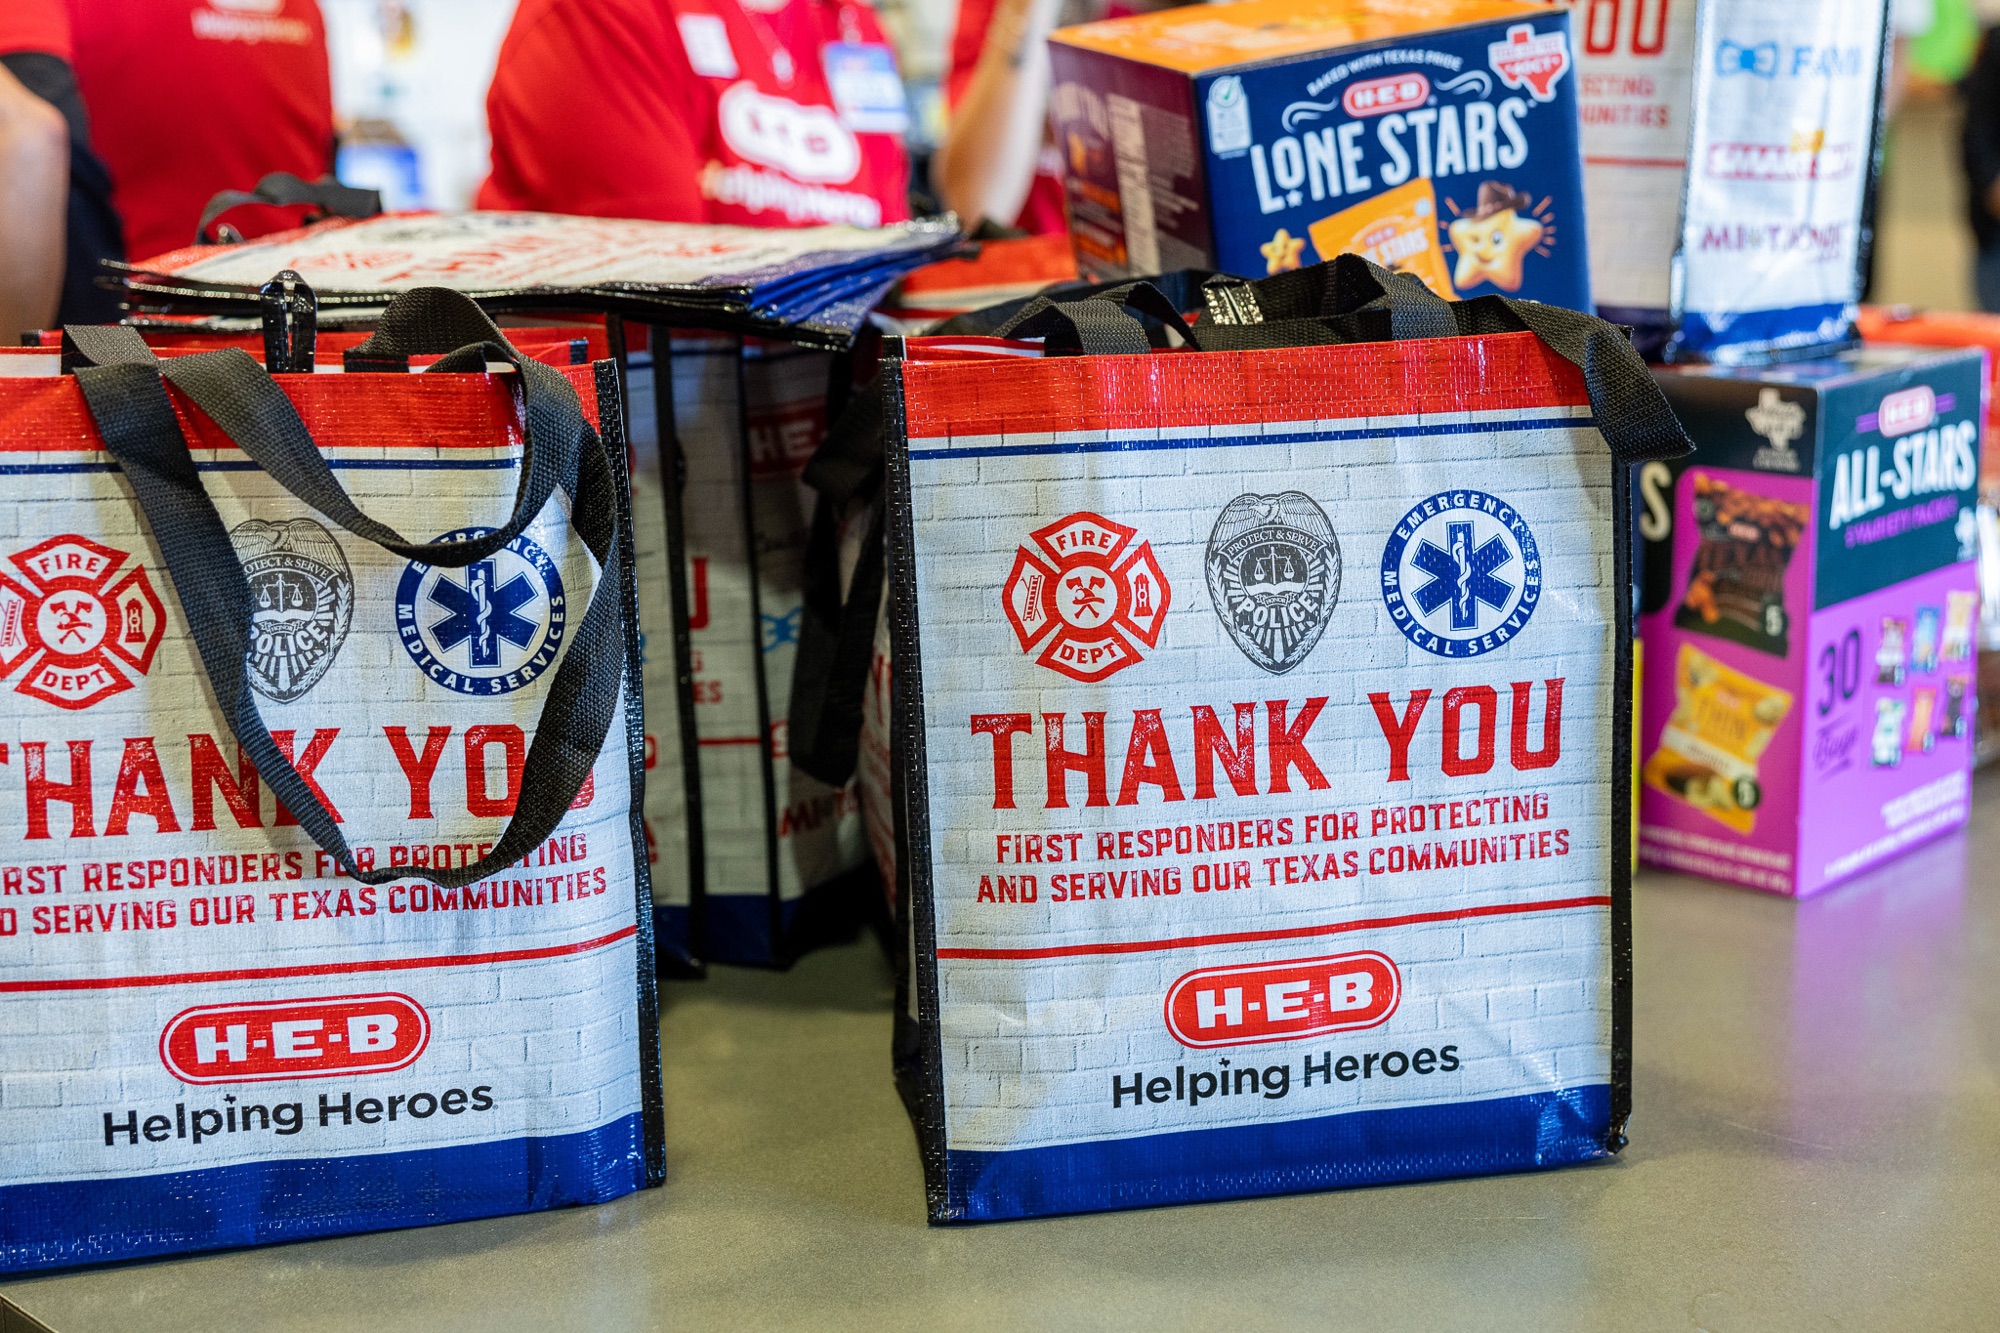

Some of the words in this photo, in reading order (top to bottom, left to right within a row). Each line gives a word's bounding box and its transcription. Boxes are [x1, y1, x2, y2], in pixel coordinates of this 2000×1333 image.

[1382, 49, 1426, 66] TEXAS
[1566, 0, 1668, 57] OU
[1250, 120, 1373, 215] LONE
[1376, 97, 1529, 186] STARS
[1829, 419, 1977, 531] ALL-STARS
[1055, 529, 1113, 552] FIRE
[1227, 530, 1275, 556] PROTECT
[1275, 530, 1285, 540] &
[1285, 530, 1320, 551] SERVE
[1396, 493, 1524, 541] EMERGENCY
[38, 553, 101, 575] FIRE
[243, 556, 283, 574] OTECT
[294, 558, 330, 579] SERVE
[1235, 591, 1320, 629] POLICE
[1383, 570, 1454, 655] MEDICAL
[1467, 559, 1540, 655] SERVICES
[397, 603, 475, 693] MEDICAL
[491, 594, 565, 693] SERVICES
[1058, 642, 1117, 665] DEPT
[1816, 627, 1861, 717] 30
[42, 669, 107, 692] DEPT
[970, 695, 1332, 809] THANK
[1367, 677, 1567, 782] YOU
[0, 728, 345, 840] HANK
[382, 723, 595, 820] YO
[996, 832, 1083, 863] FIRST
[1096, 817, 1294, 860] RESPONDERS
[1304, 811, 1360, 843] FOR
[1371, 792, 1549, 837] PROTECTING
[2, 864, 67, 896] RST
[82, 851, 303, 893] RESPONDERS
[976, 875, 1038, 903] AND
[1051, 866, 1182, 903] SERVING
[1192, 860, 1252, 893] OUR
[1263, 850, 1359, 887] TEXAS
[1369, 828, 1571, 876] COMMUNITIES
[33, 899, 177, 934] SERVING
[190, 894, 255, 927] OUR
[269, 886, 378, 922] TEXAS
[388, 865, 607, 914] COMMUNITIES
[1195, 971, 1375, 1029] H-E-B
[194, 1013, 400, 1064] H-E-B
[1112, 1057, 1290, 1109] Helping
[1303, 1044, 1460, 1088] Heroes
[103, 1093, 304, 1146] Helping
[318, 1085, 494, 1128] Heroes
